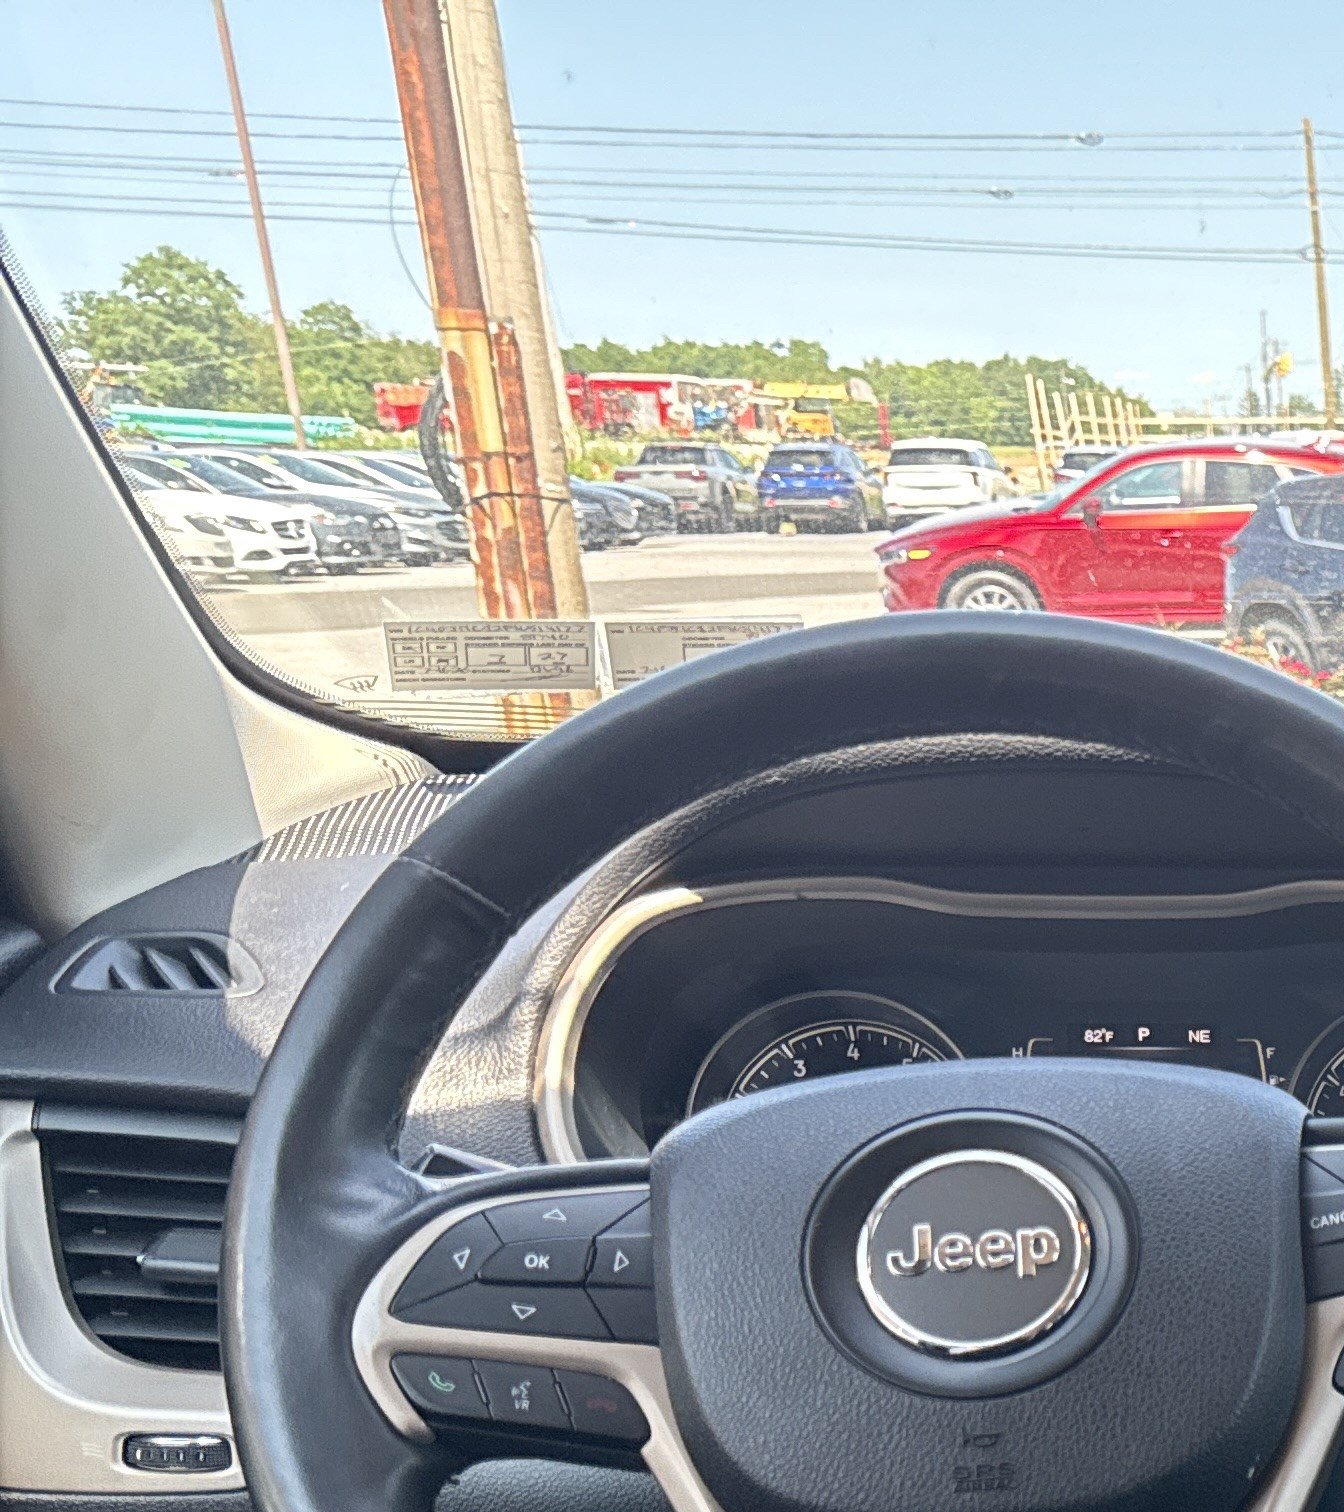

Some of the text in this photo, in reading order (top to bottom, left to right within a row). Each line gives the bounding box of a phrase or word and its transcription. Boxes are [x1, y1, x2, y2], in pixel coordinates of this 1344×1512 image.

[1137, 1026, 1151, 1042] P
[1188, 1029, 1211, 1044] NE
[846, 1042, 861, 1061] 4
[1266, 1047, 1276, 1059] F
[793, 1059, 807, 1078] 3
[886, 1223, 1060, 1279] Jeep
[524, 1253, 550, 1271] OK
